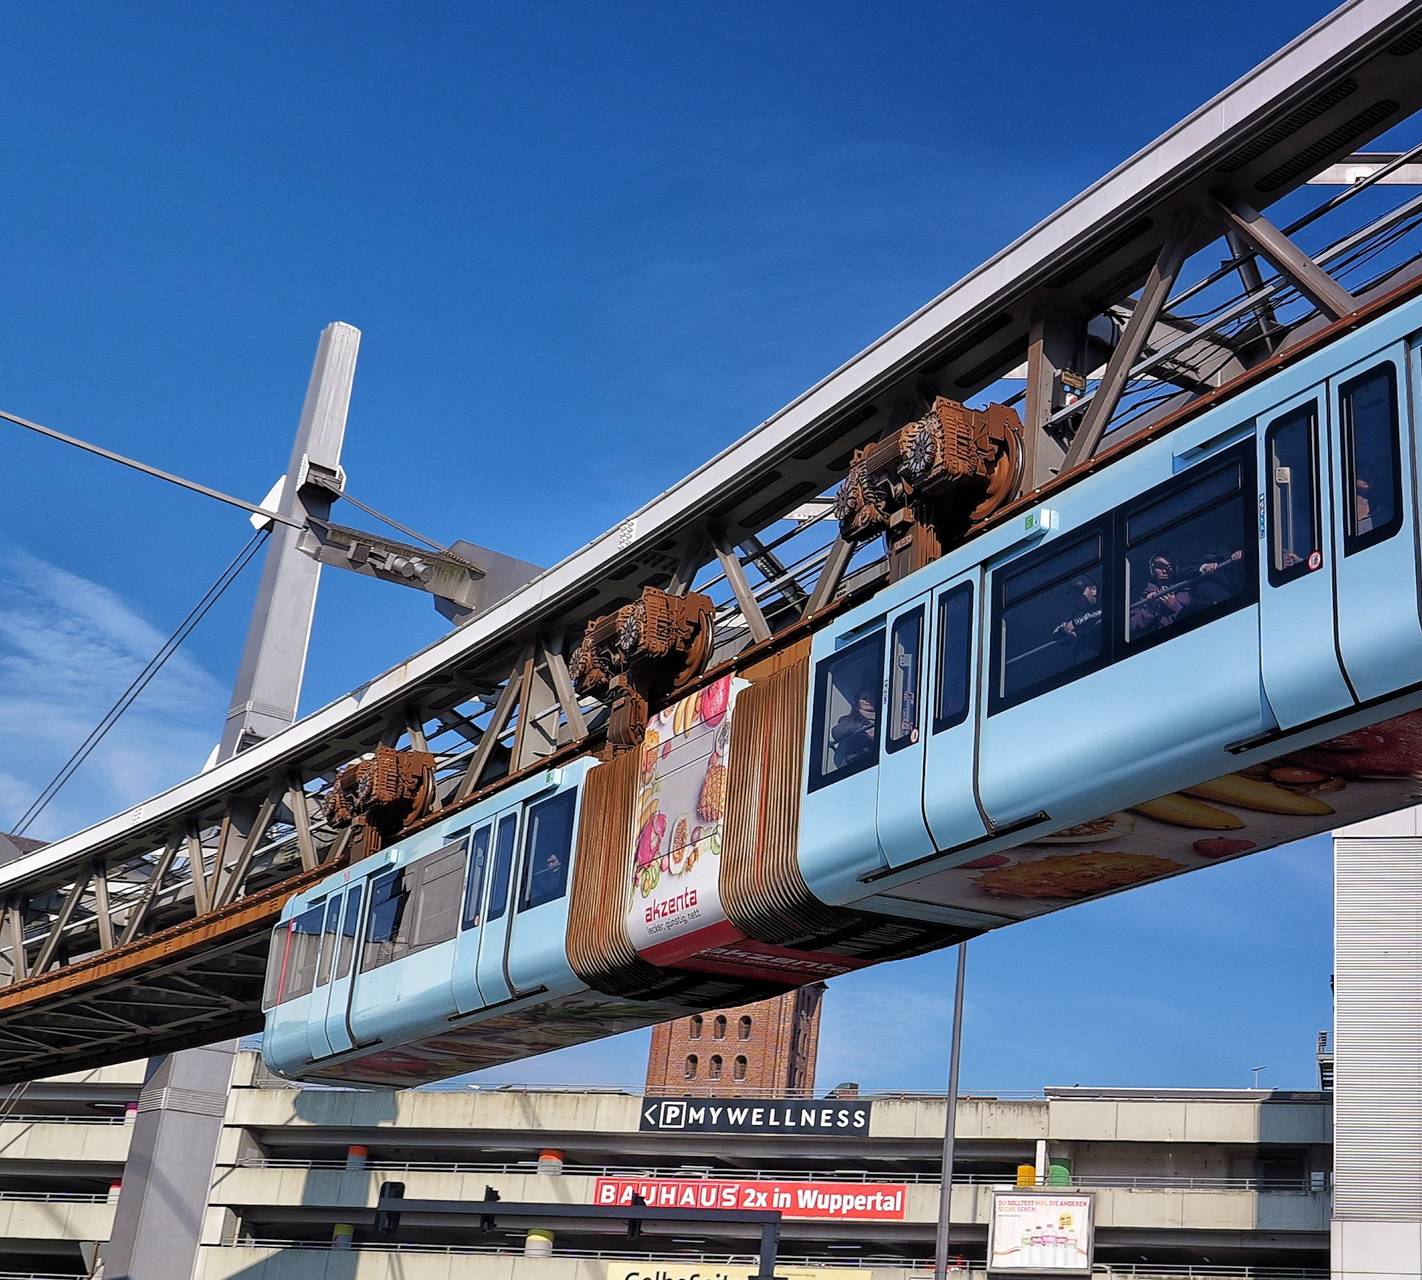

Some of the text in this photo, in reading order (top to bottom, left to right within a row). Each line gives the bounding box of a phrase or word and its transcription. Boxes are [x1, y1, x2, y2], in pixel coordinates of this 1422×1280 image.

[645, 886, 698, 924] akzenta
[665, 1106, 866, 1129] P MYWELLNESS
[600, 1183, 903, 1215] BAUHAUS 2x in Wuppertal
